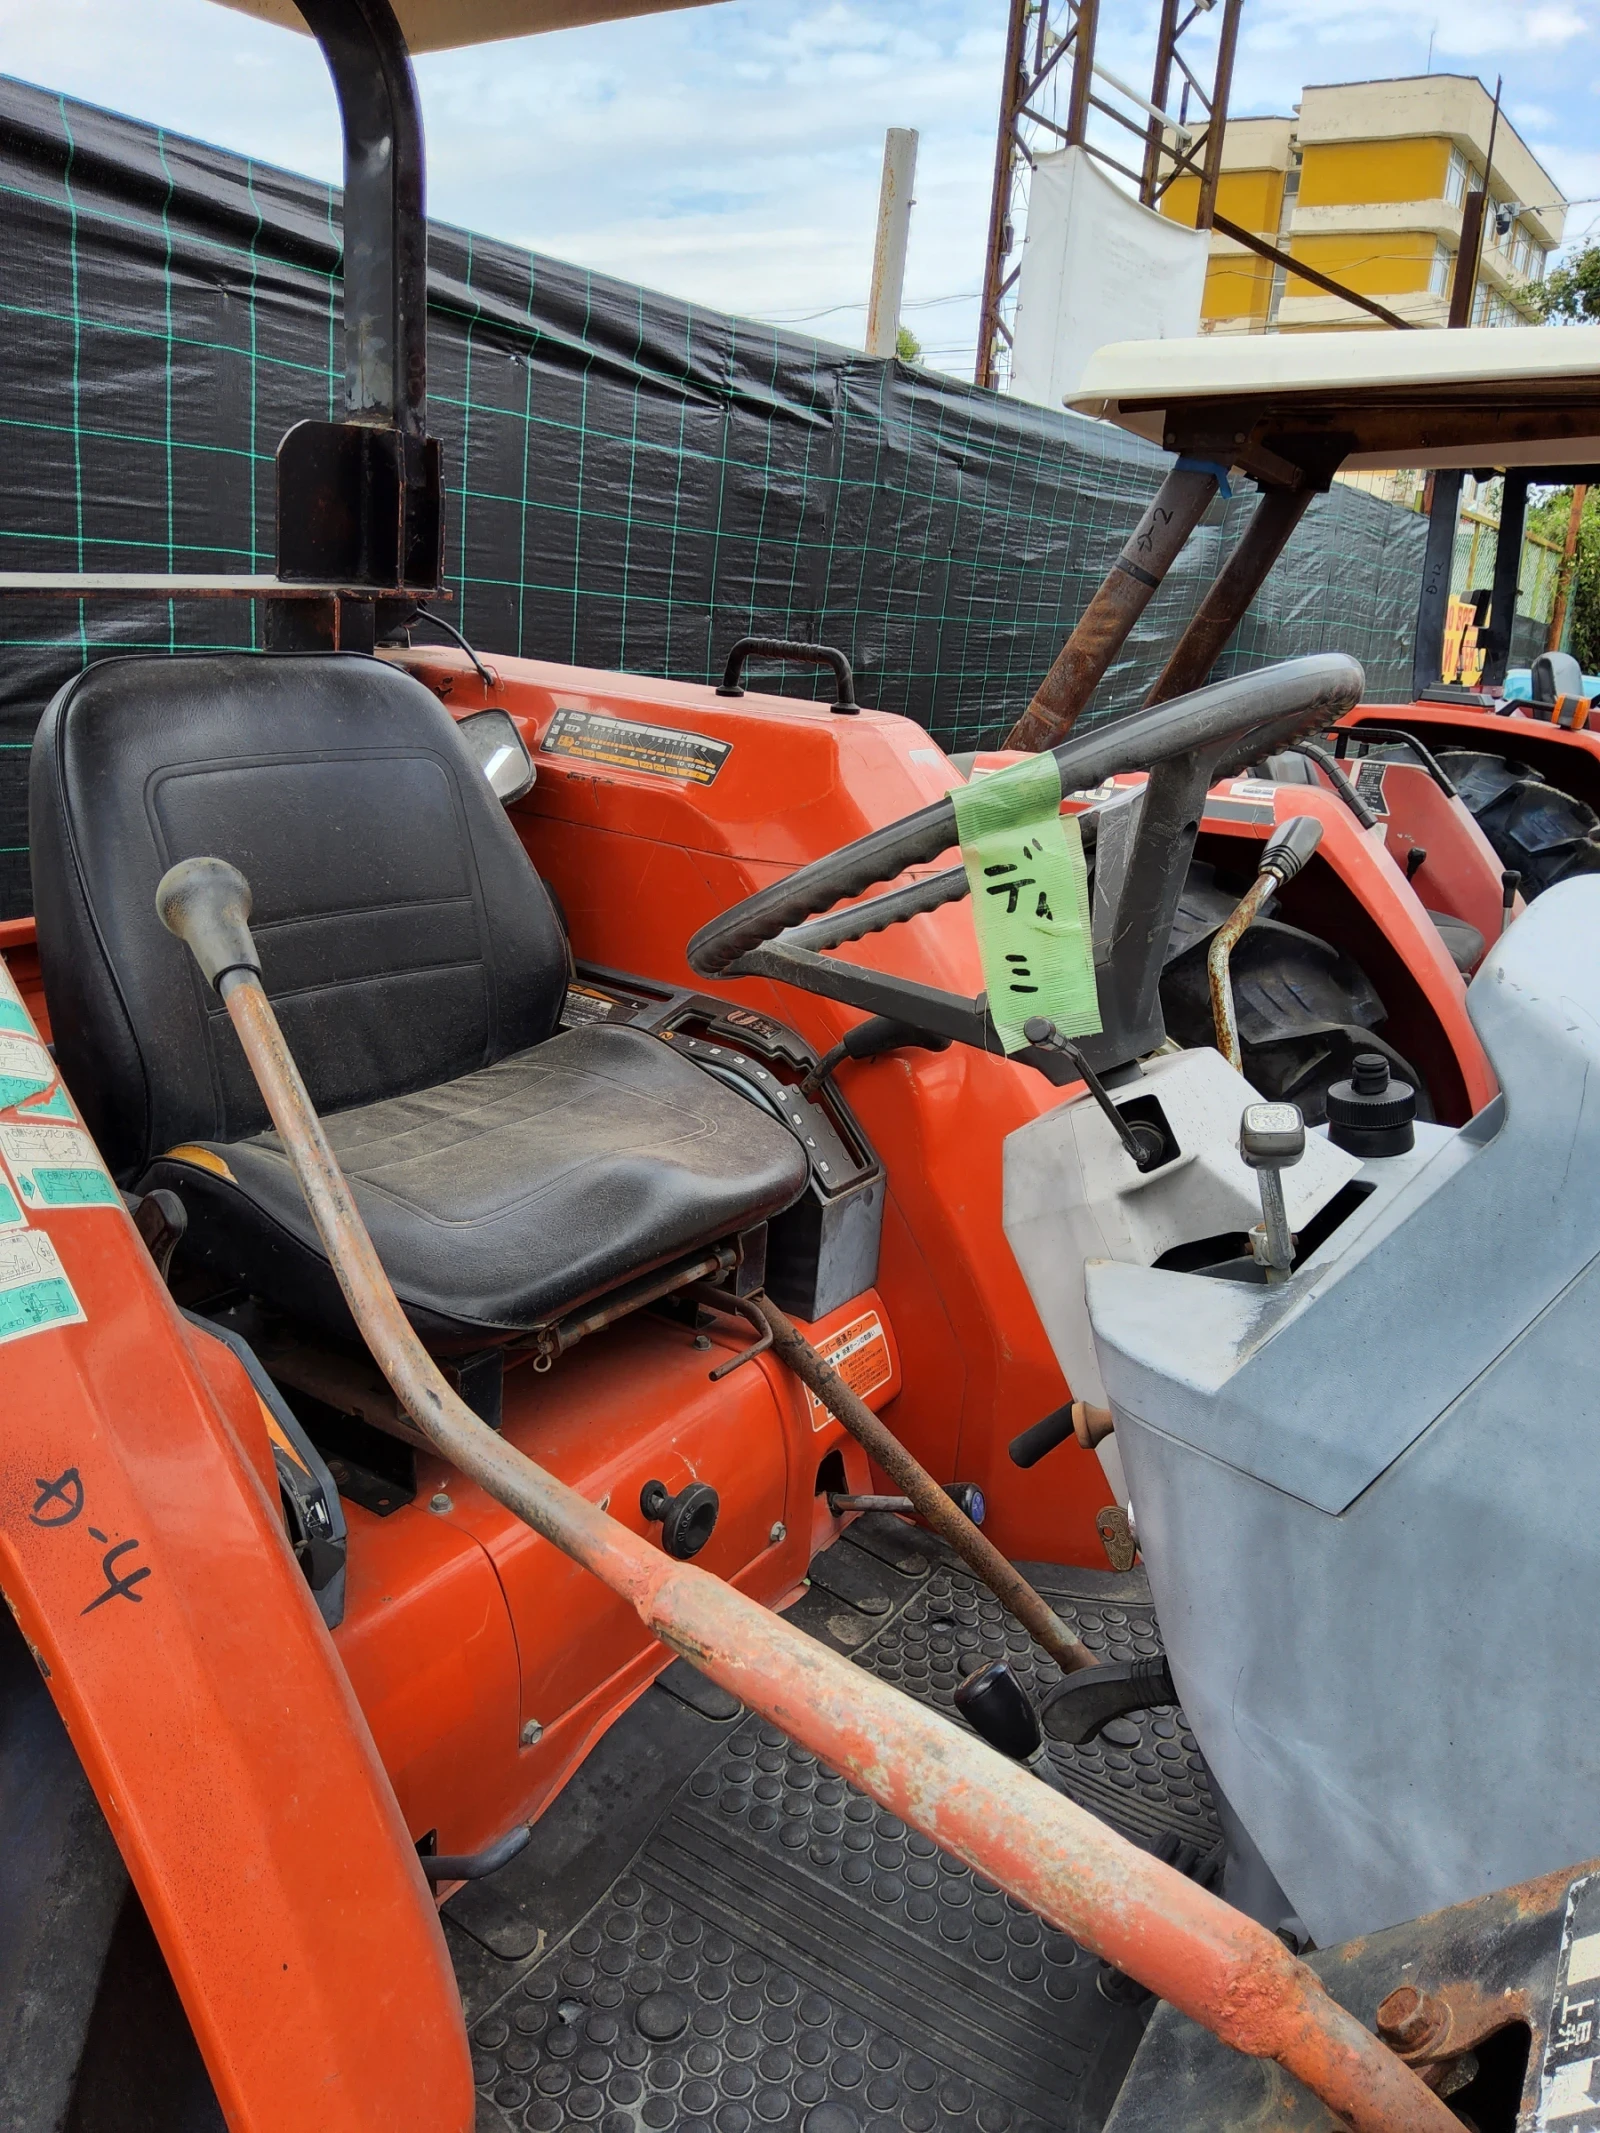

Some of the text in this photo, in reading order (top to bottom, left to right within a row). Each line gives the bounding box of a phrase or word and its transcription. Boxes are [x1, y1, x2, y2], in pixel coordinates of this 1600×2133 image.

[756, 1071, 768, 1080] 4
[776, 1090, 787, 1101] 5
[792, 1114, 803, 1125] 6
[806, 1137, 815, 1148] 7
[820, 1162, 830, 1172] 8
